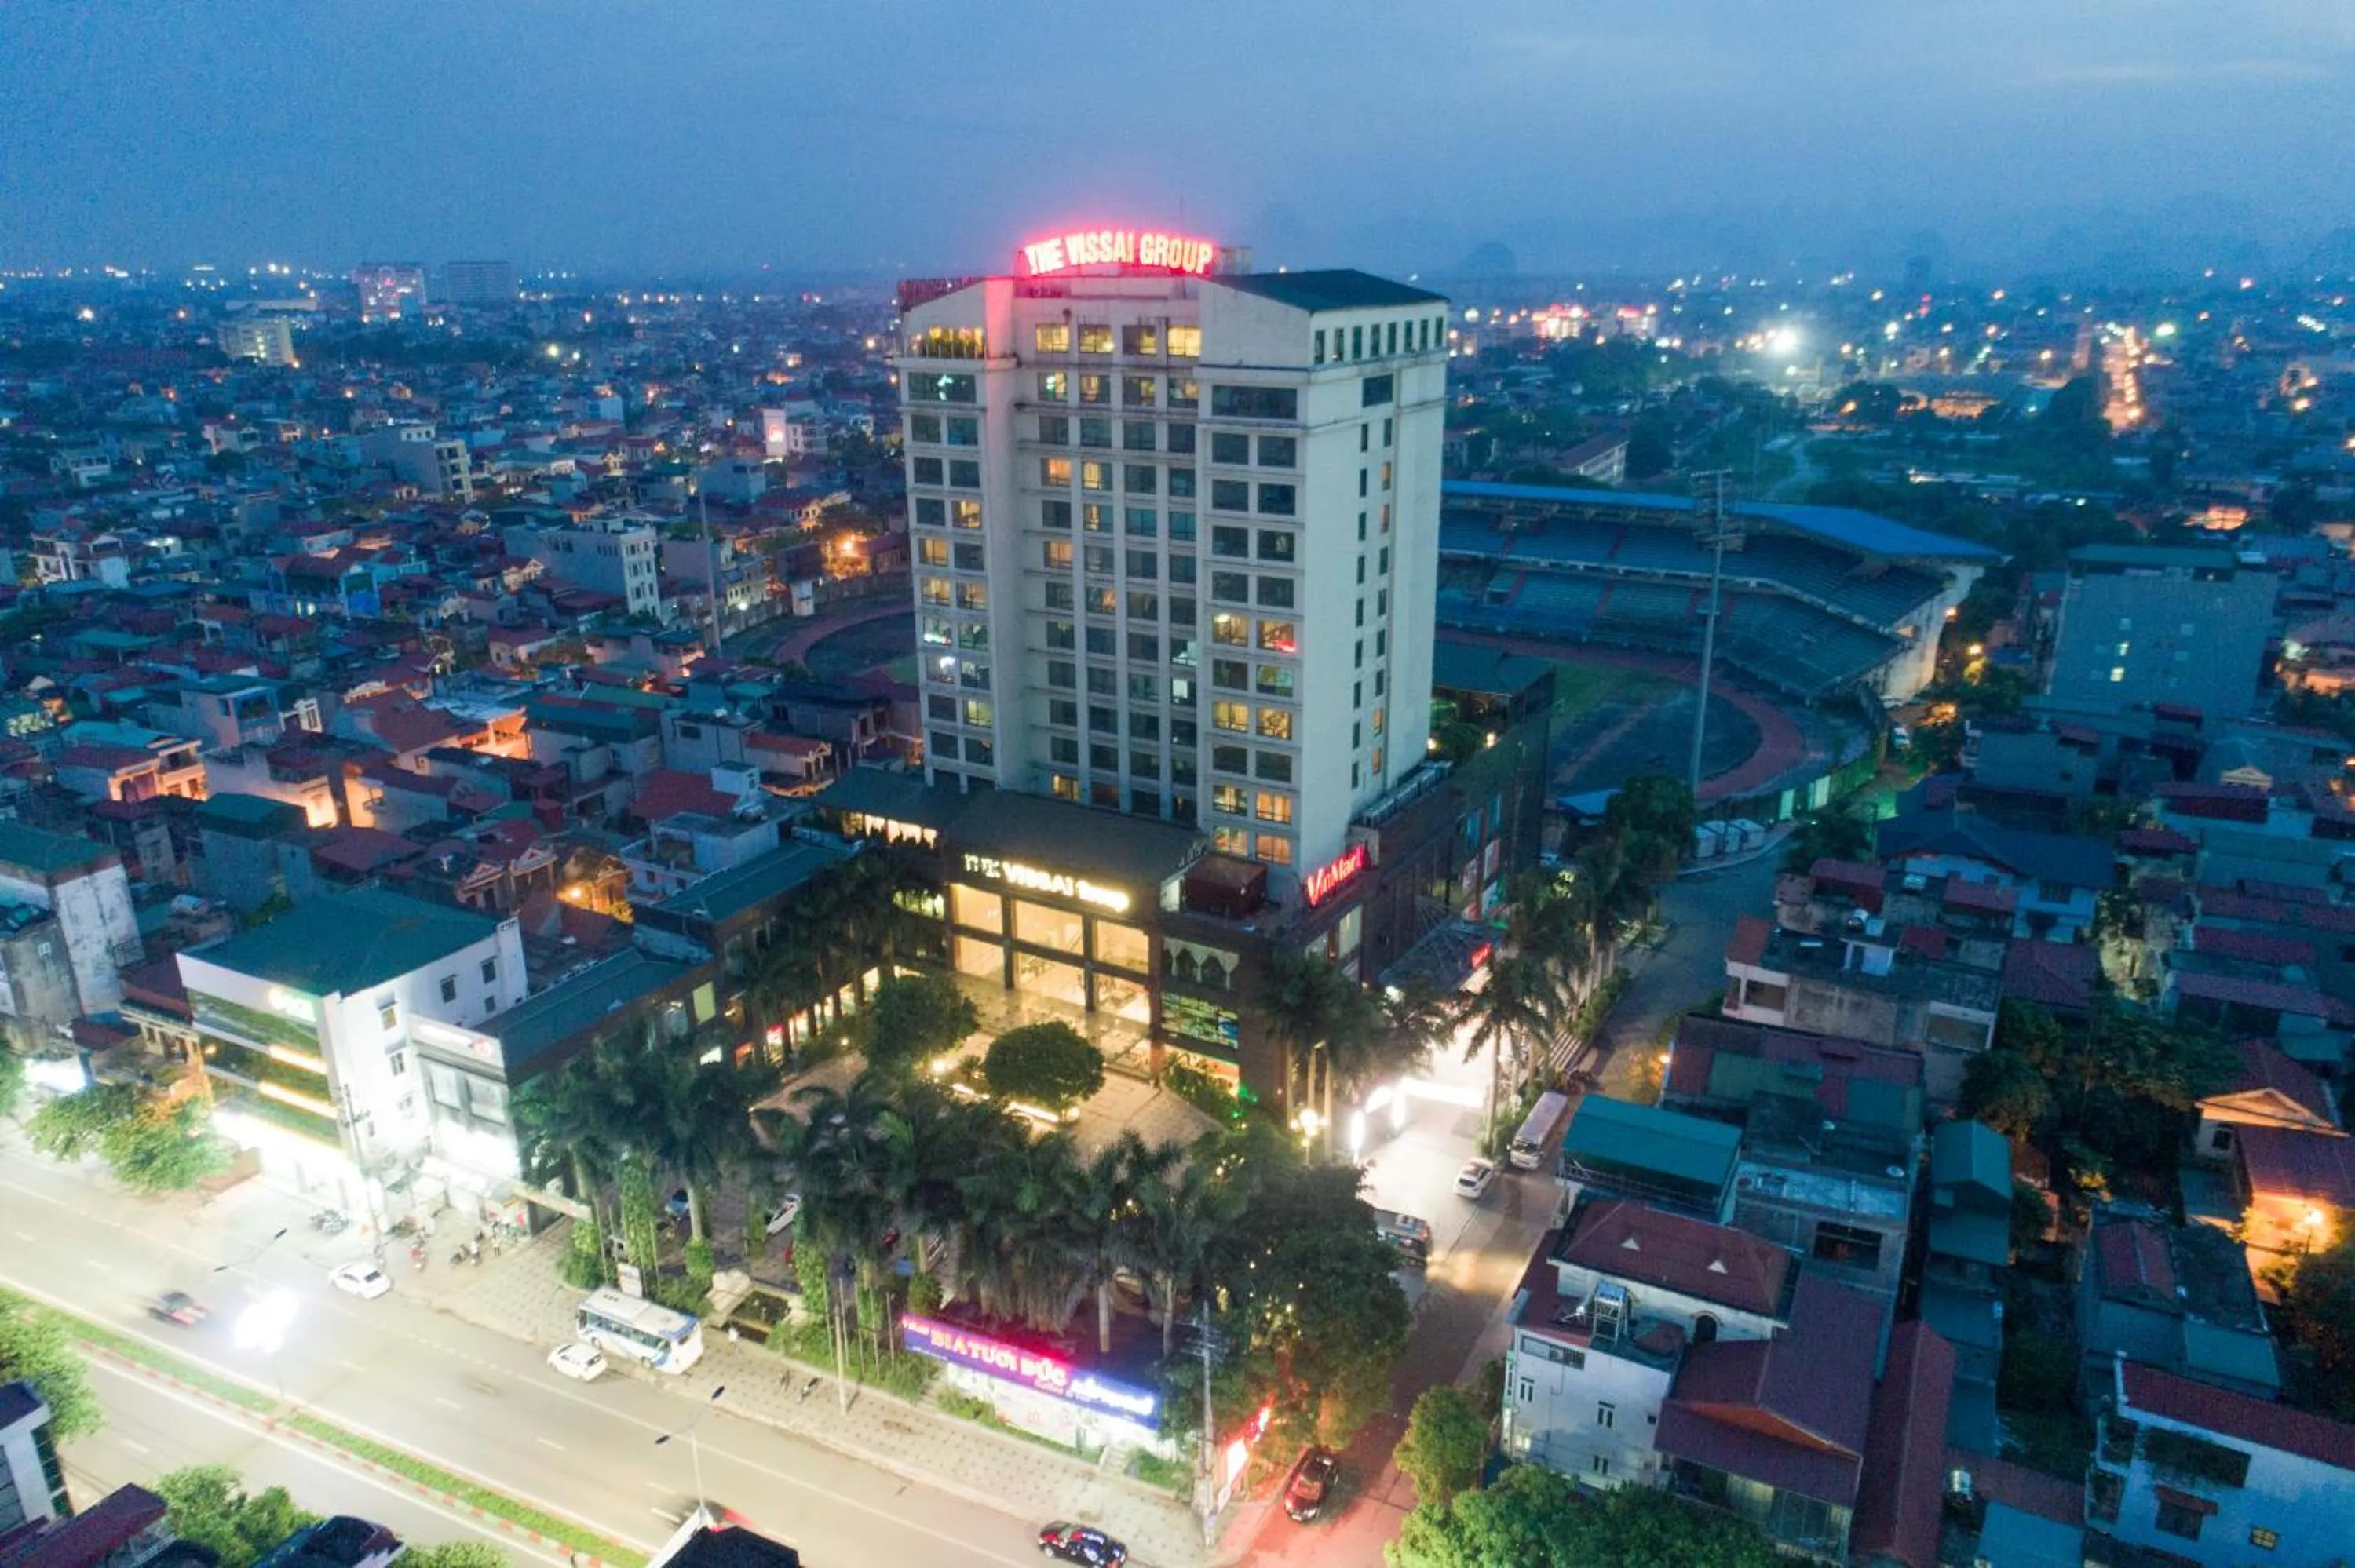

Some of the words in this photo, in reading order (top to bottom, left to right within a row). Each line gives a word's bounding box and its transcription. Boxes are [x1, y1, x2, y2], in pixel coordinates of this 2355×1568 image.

[1024, 238, 1064, 275] THE
[1065, 230, 1134, 265] VISSAI
[1140, 232, 1213, 273] GROUP
[931, 1329, 968, 1355] BIA
